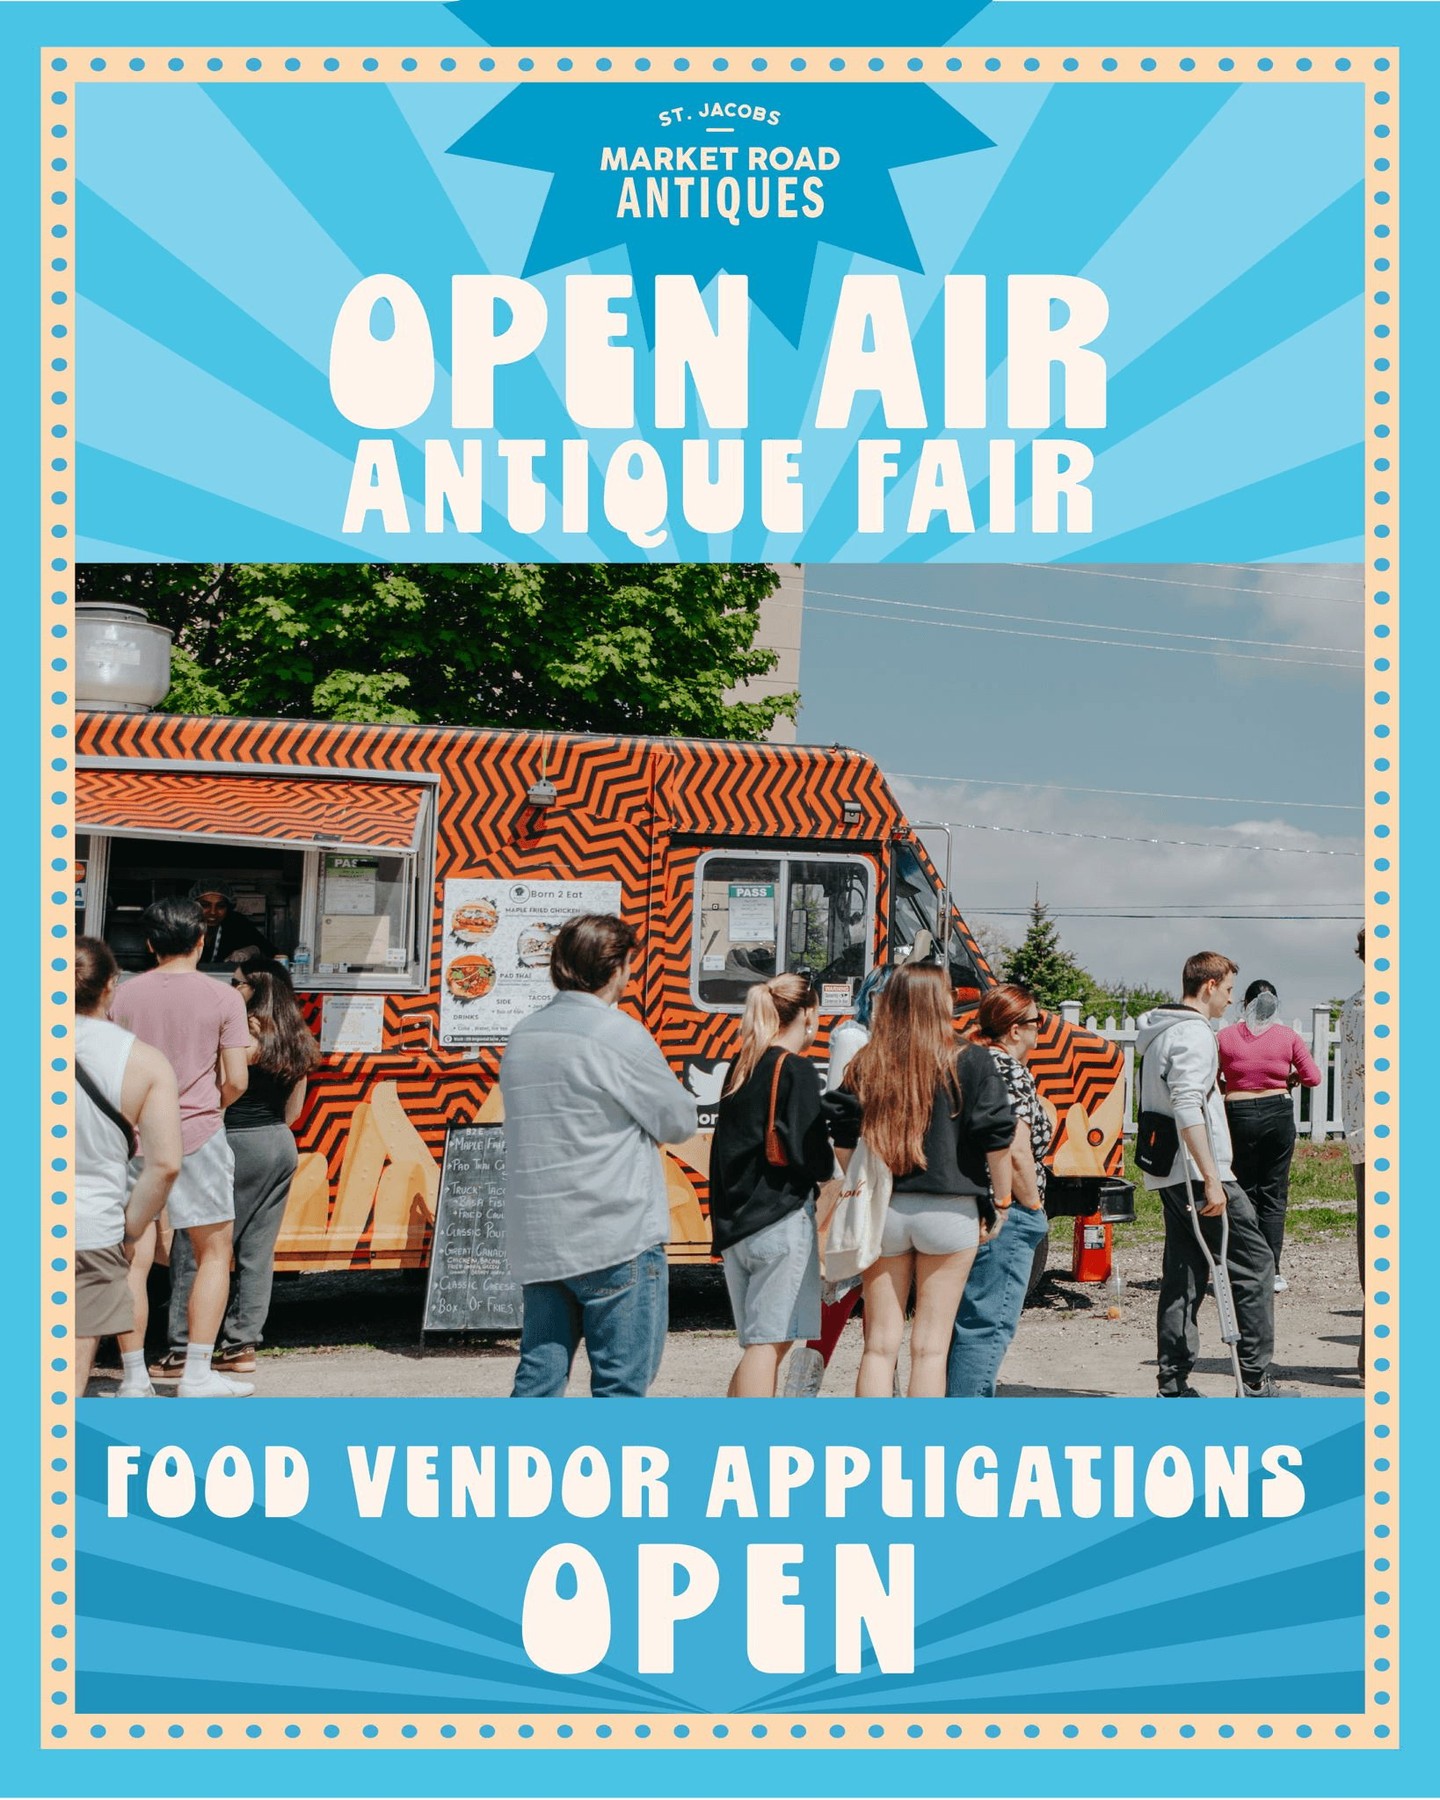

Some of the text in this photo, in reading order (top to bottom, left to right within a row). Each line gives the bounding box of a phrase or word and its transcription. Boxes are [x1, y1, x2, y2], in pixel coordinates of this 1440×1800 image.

[334, 858, 368, 868] PAS
[531, 890, 554, 898] Born
[558, 890, 564, 898] 2
[567, 890, 583, 898] Eat
[736, 888, 767, 897] PASS
